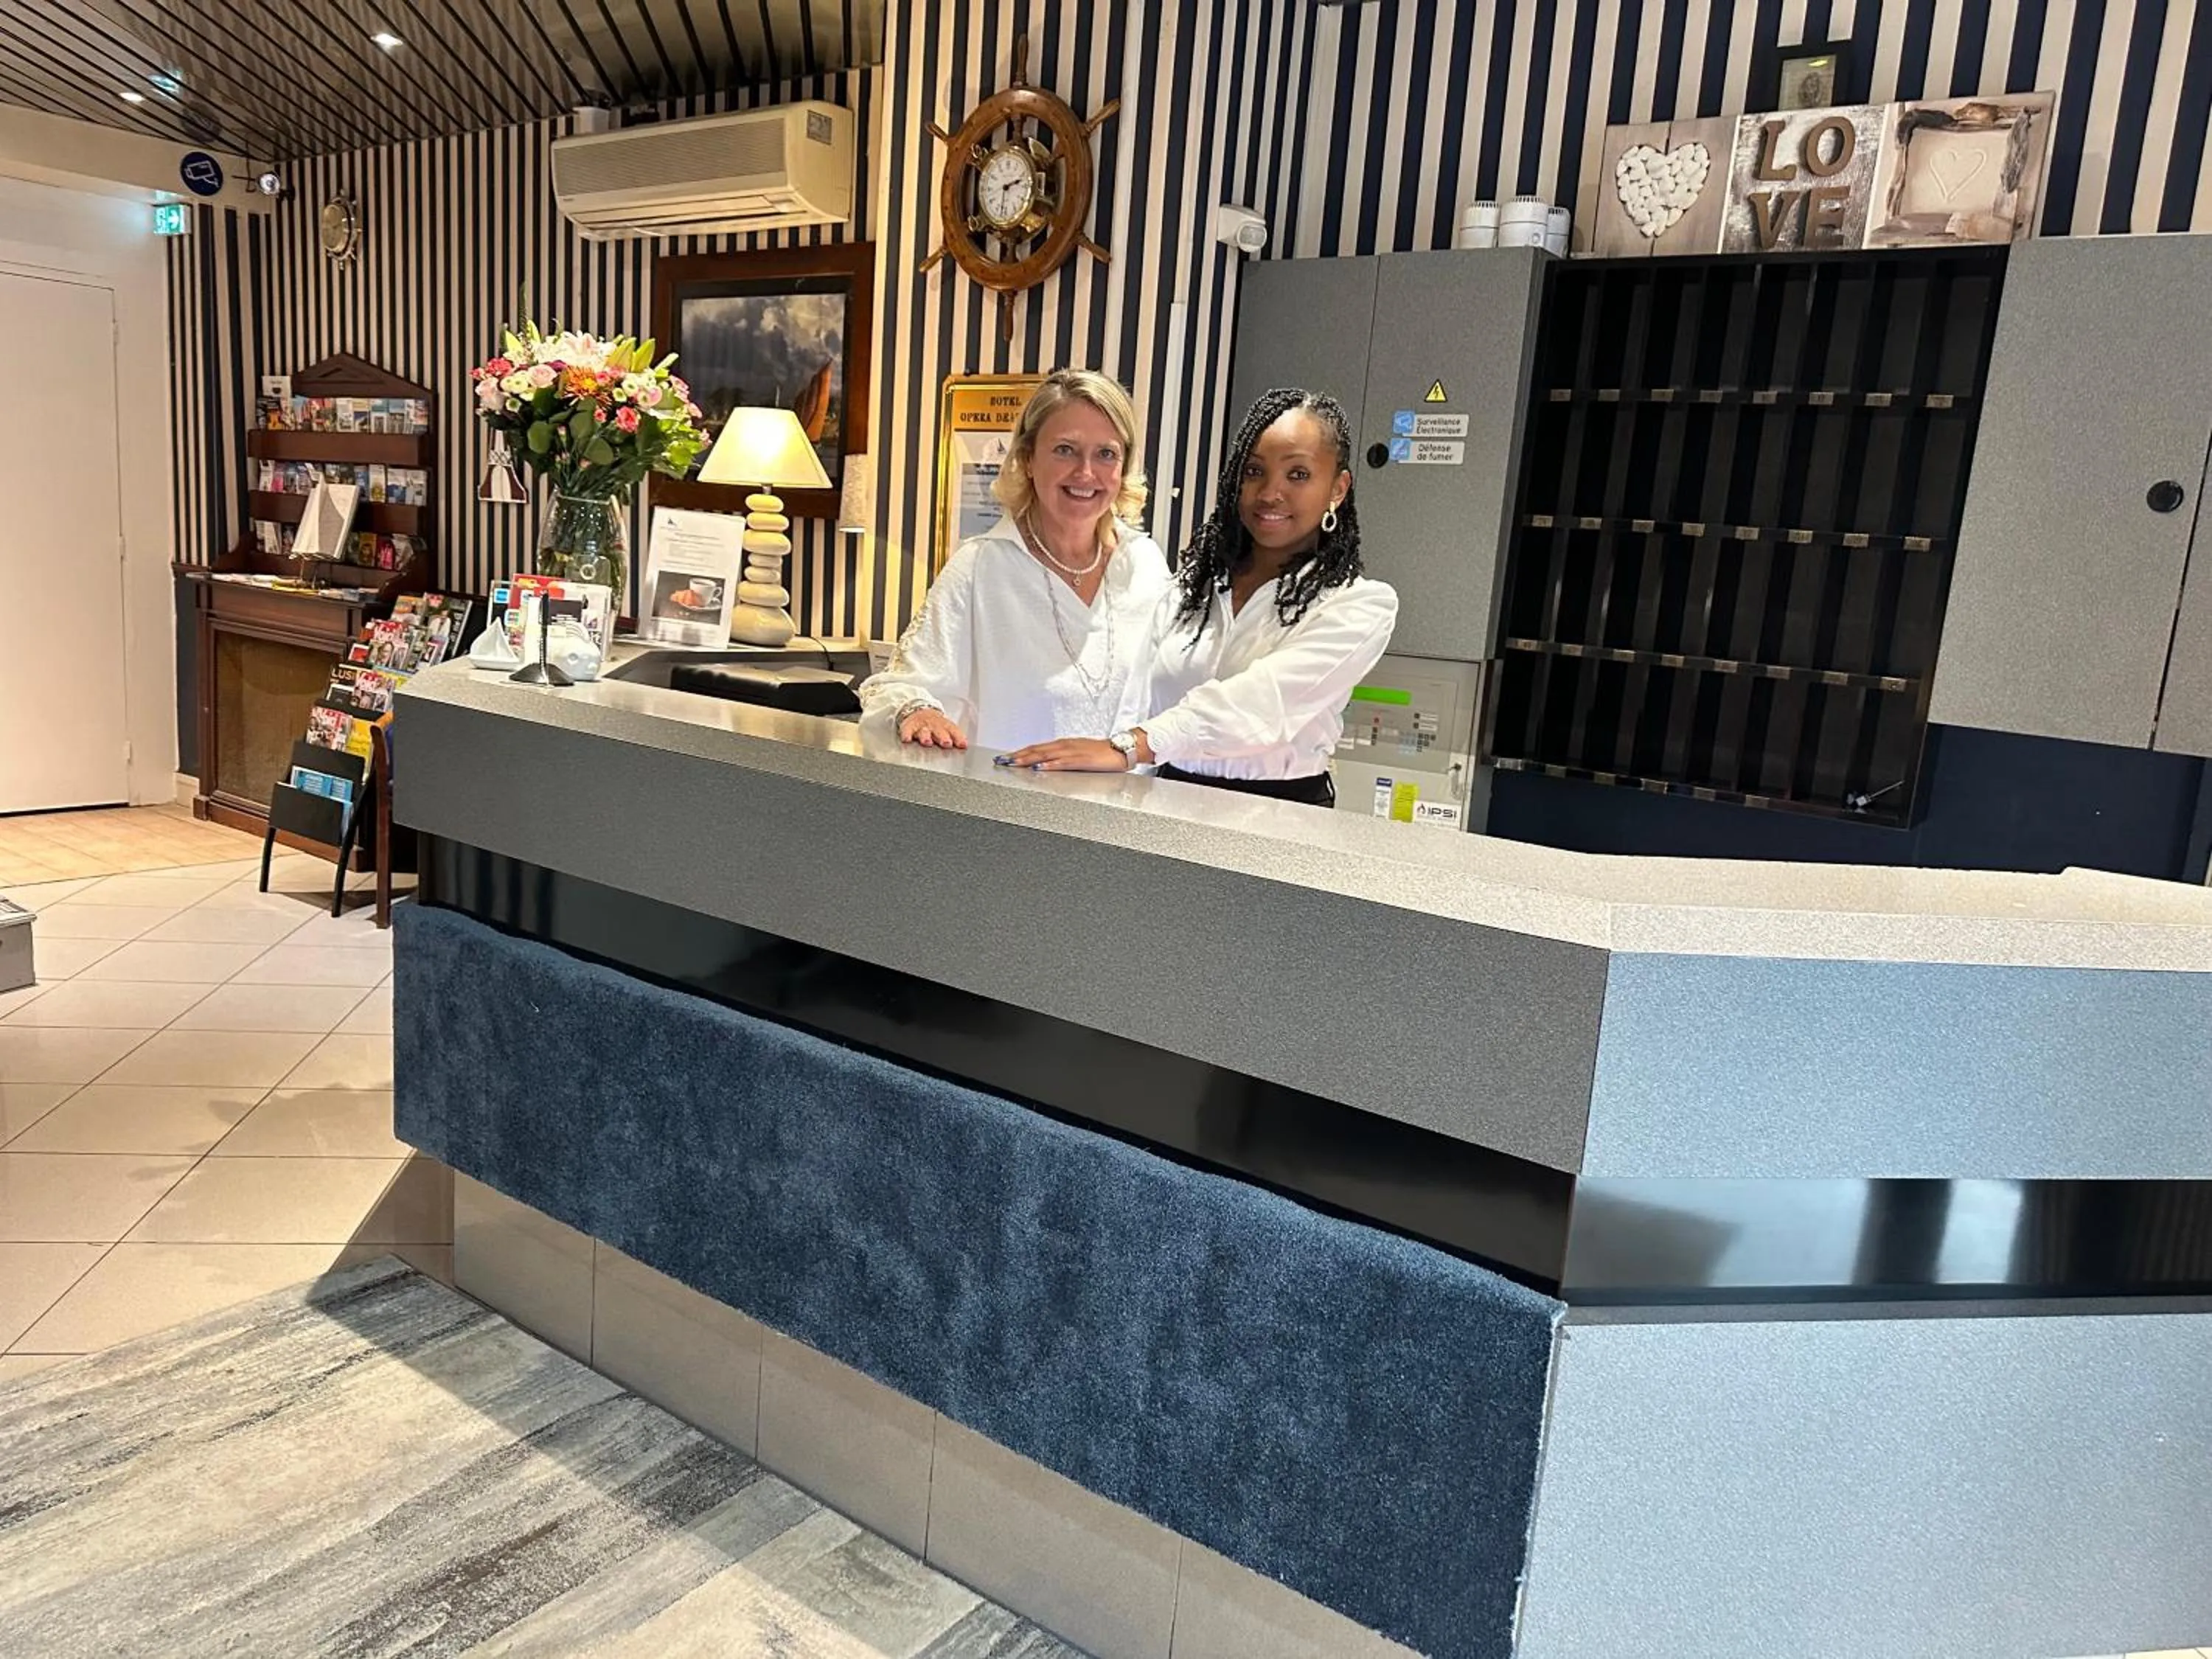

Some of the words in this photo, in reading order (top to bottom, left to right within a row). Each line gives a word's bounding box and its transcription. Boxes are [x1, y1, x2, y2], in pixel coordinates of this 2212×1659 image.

[990, 396, 1022, 406] HOTEL
[960, 412, 992, 422] OPERA
[1430, 453, 1453, 461] fumer
